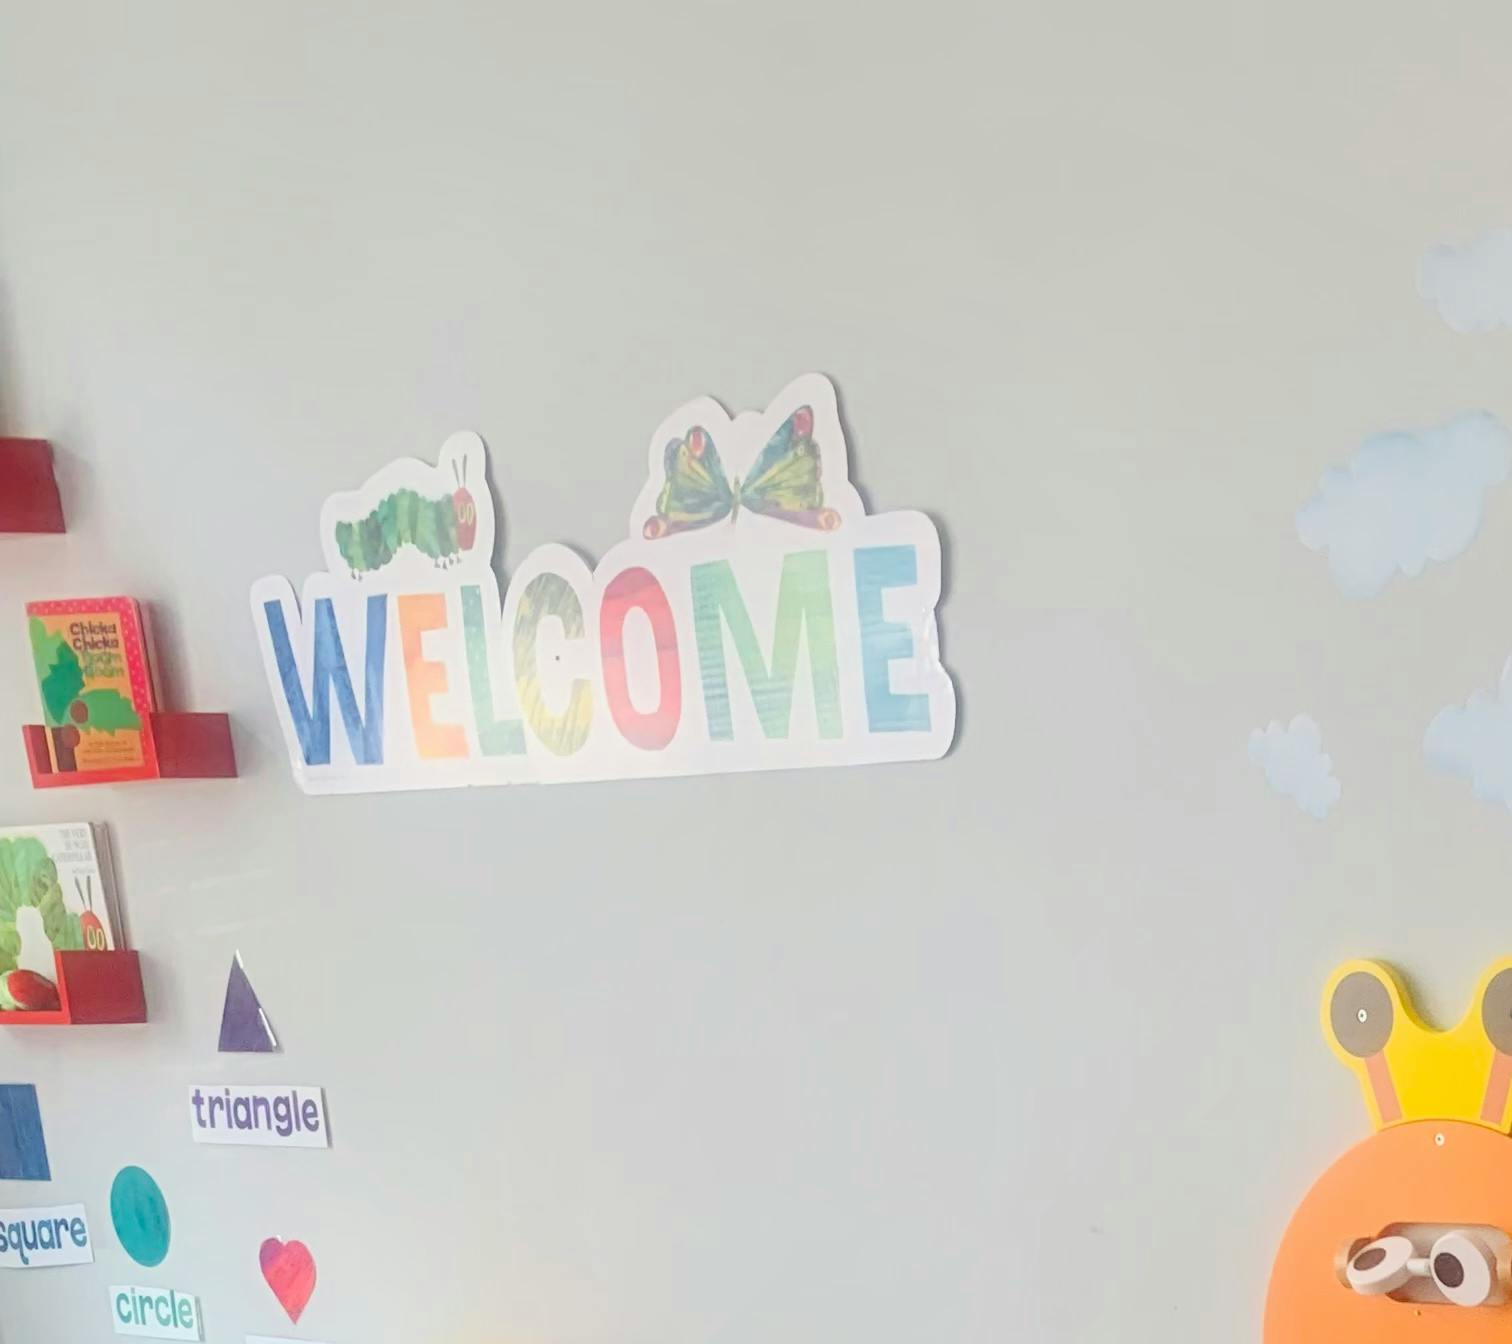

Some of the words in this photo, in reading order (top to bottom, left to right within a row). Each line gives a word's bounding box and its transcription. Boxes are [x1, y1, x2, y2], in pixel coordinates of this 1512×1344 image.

[70, 620, 116, 637] Chicka
[72, 637, 119, 652] Chicka
[263, 544, 933, 766] WELCOME
[192, 1088, 320, 1138] triangle
[0, 1217, 87, 1266] square
[116, 1289, 194, 1329] circle
